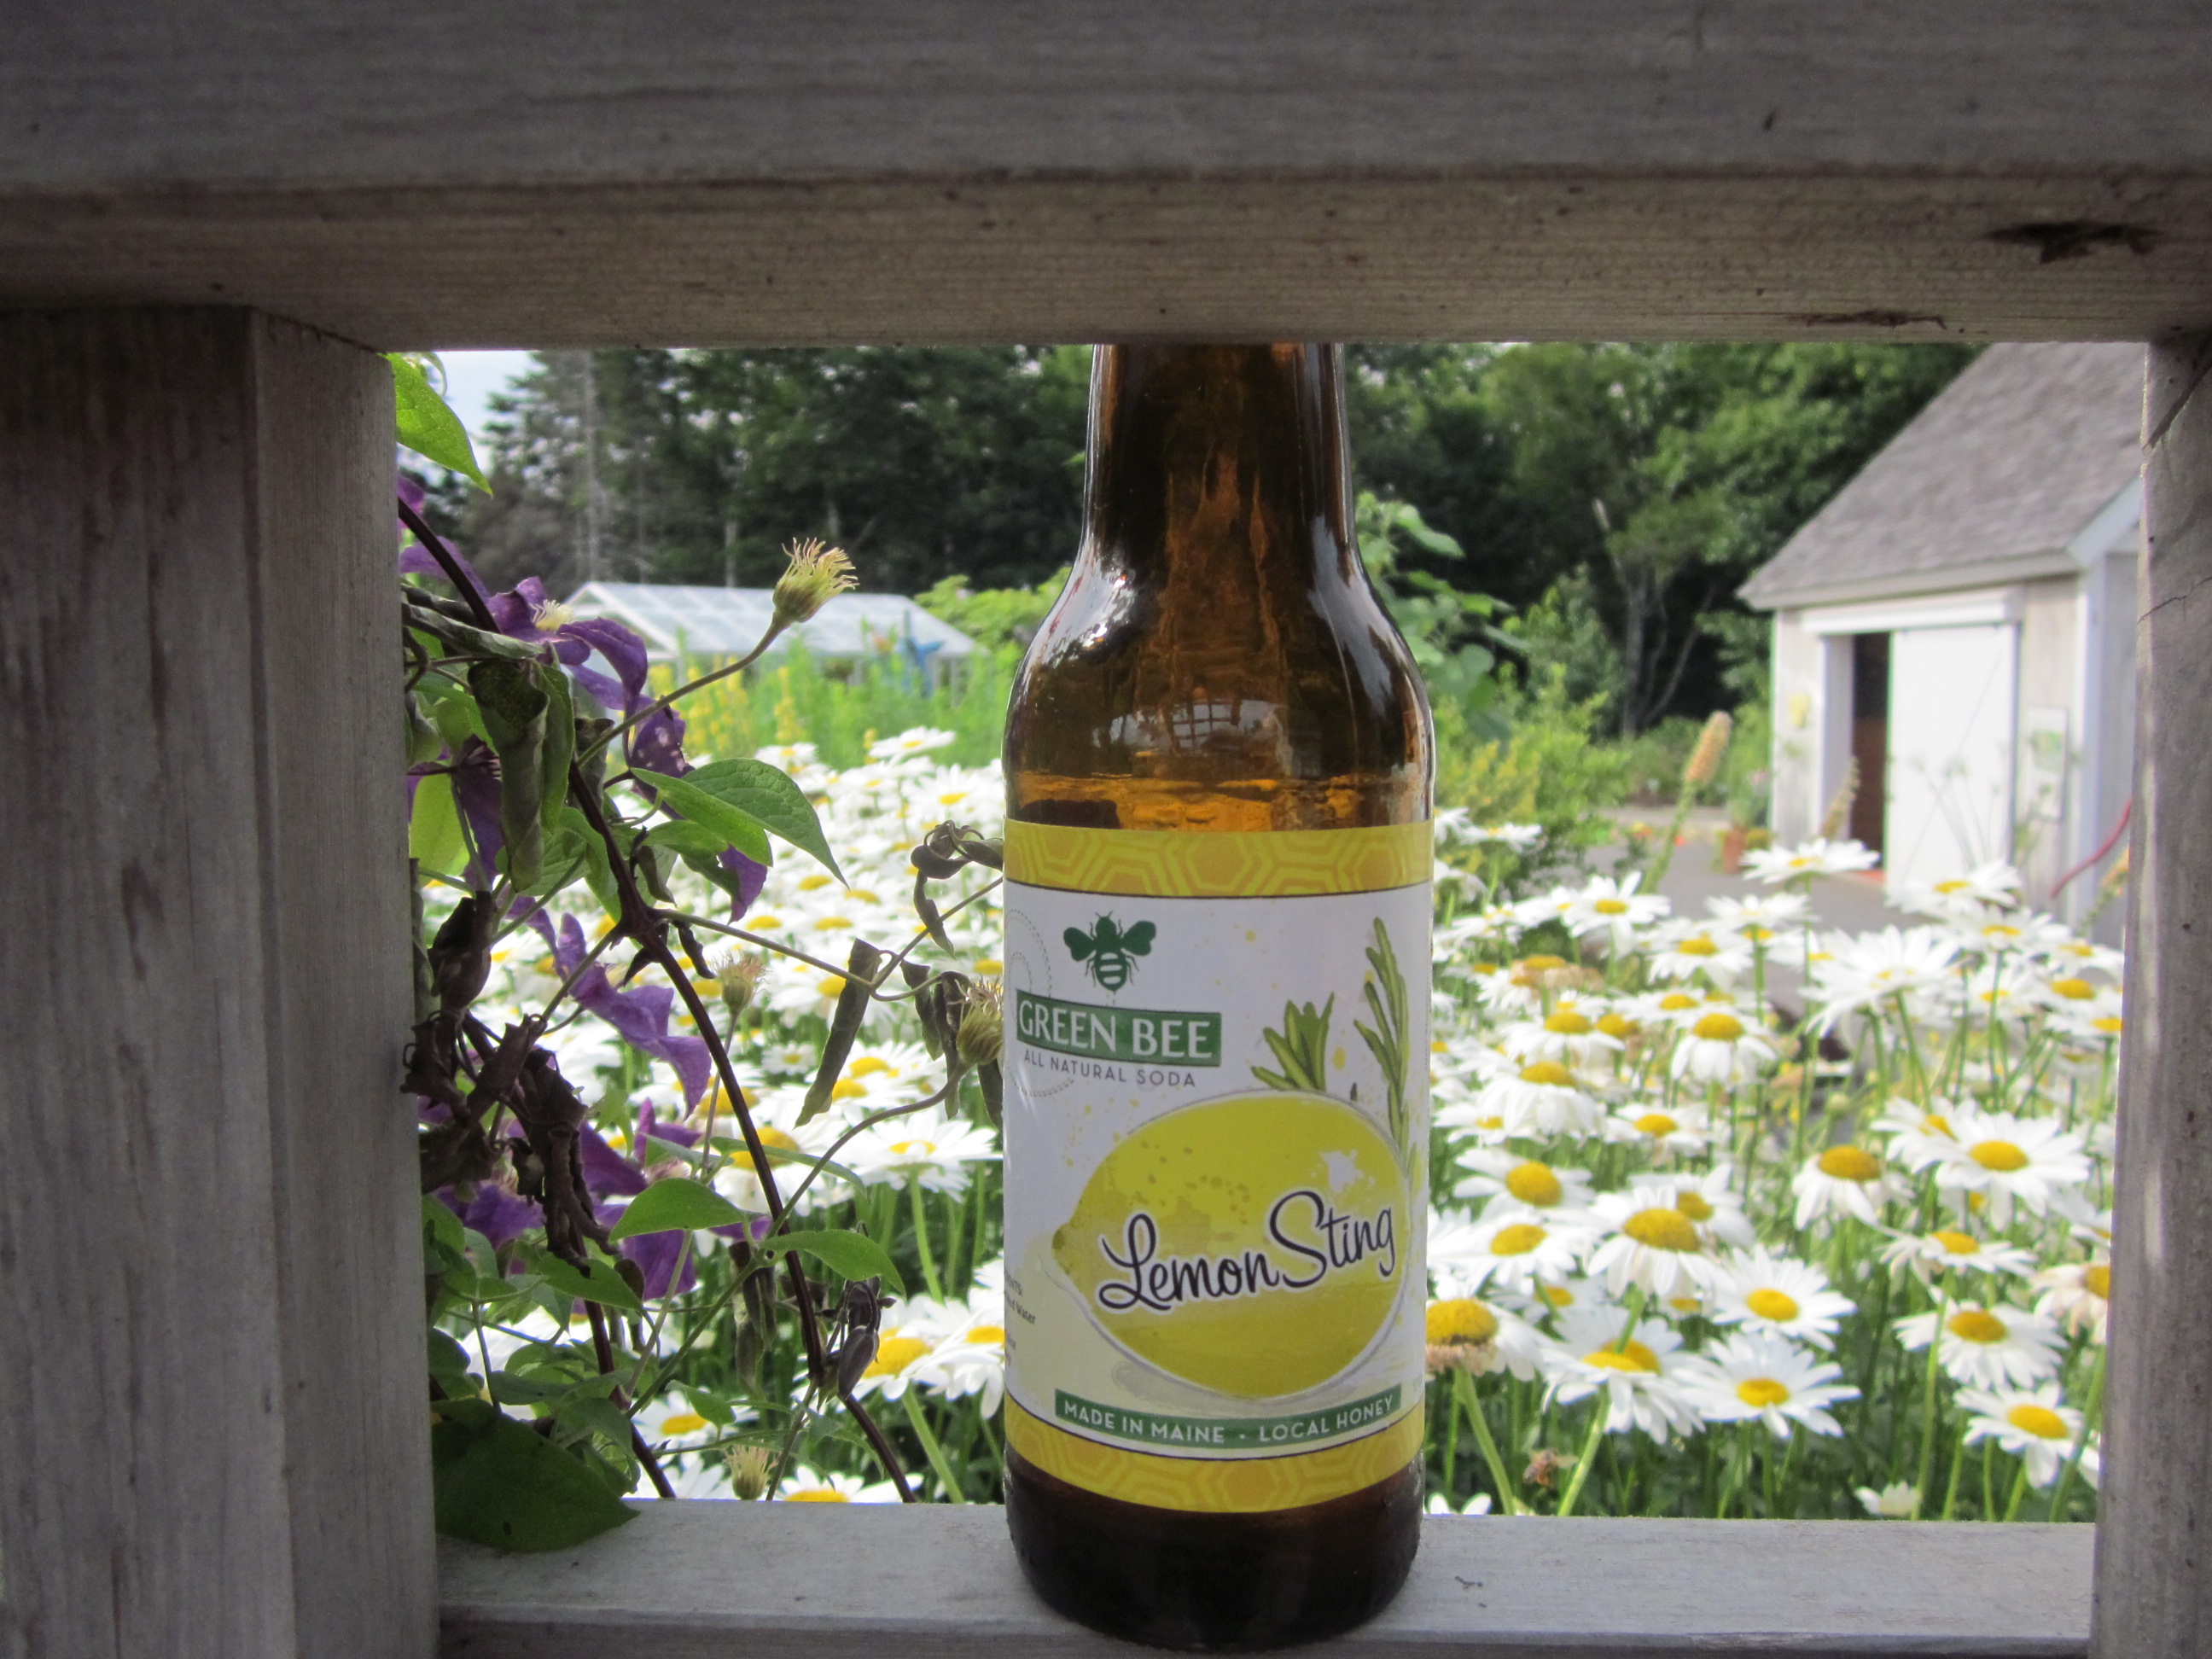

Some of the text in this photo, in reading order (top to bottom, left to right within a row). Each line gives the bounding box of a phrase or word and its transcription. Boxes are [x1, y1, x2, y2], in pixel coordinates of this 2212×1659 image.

[1018, 999, 1213, 1059] GREEN BEE
[1024, 1049, 1196, 1088] ALL NATURAL SODA
[1098, 1190, 1396, 1312] Lemon Sting
[1063, 1394, 1394, 1445] MADE IN MAINE LOCAL HONEY
